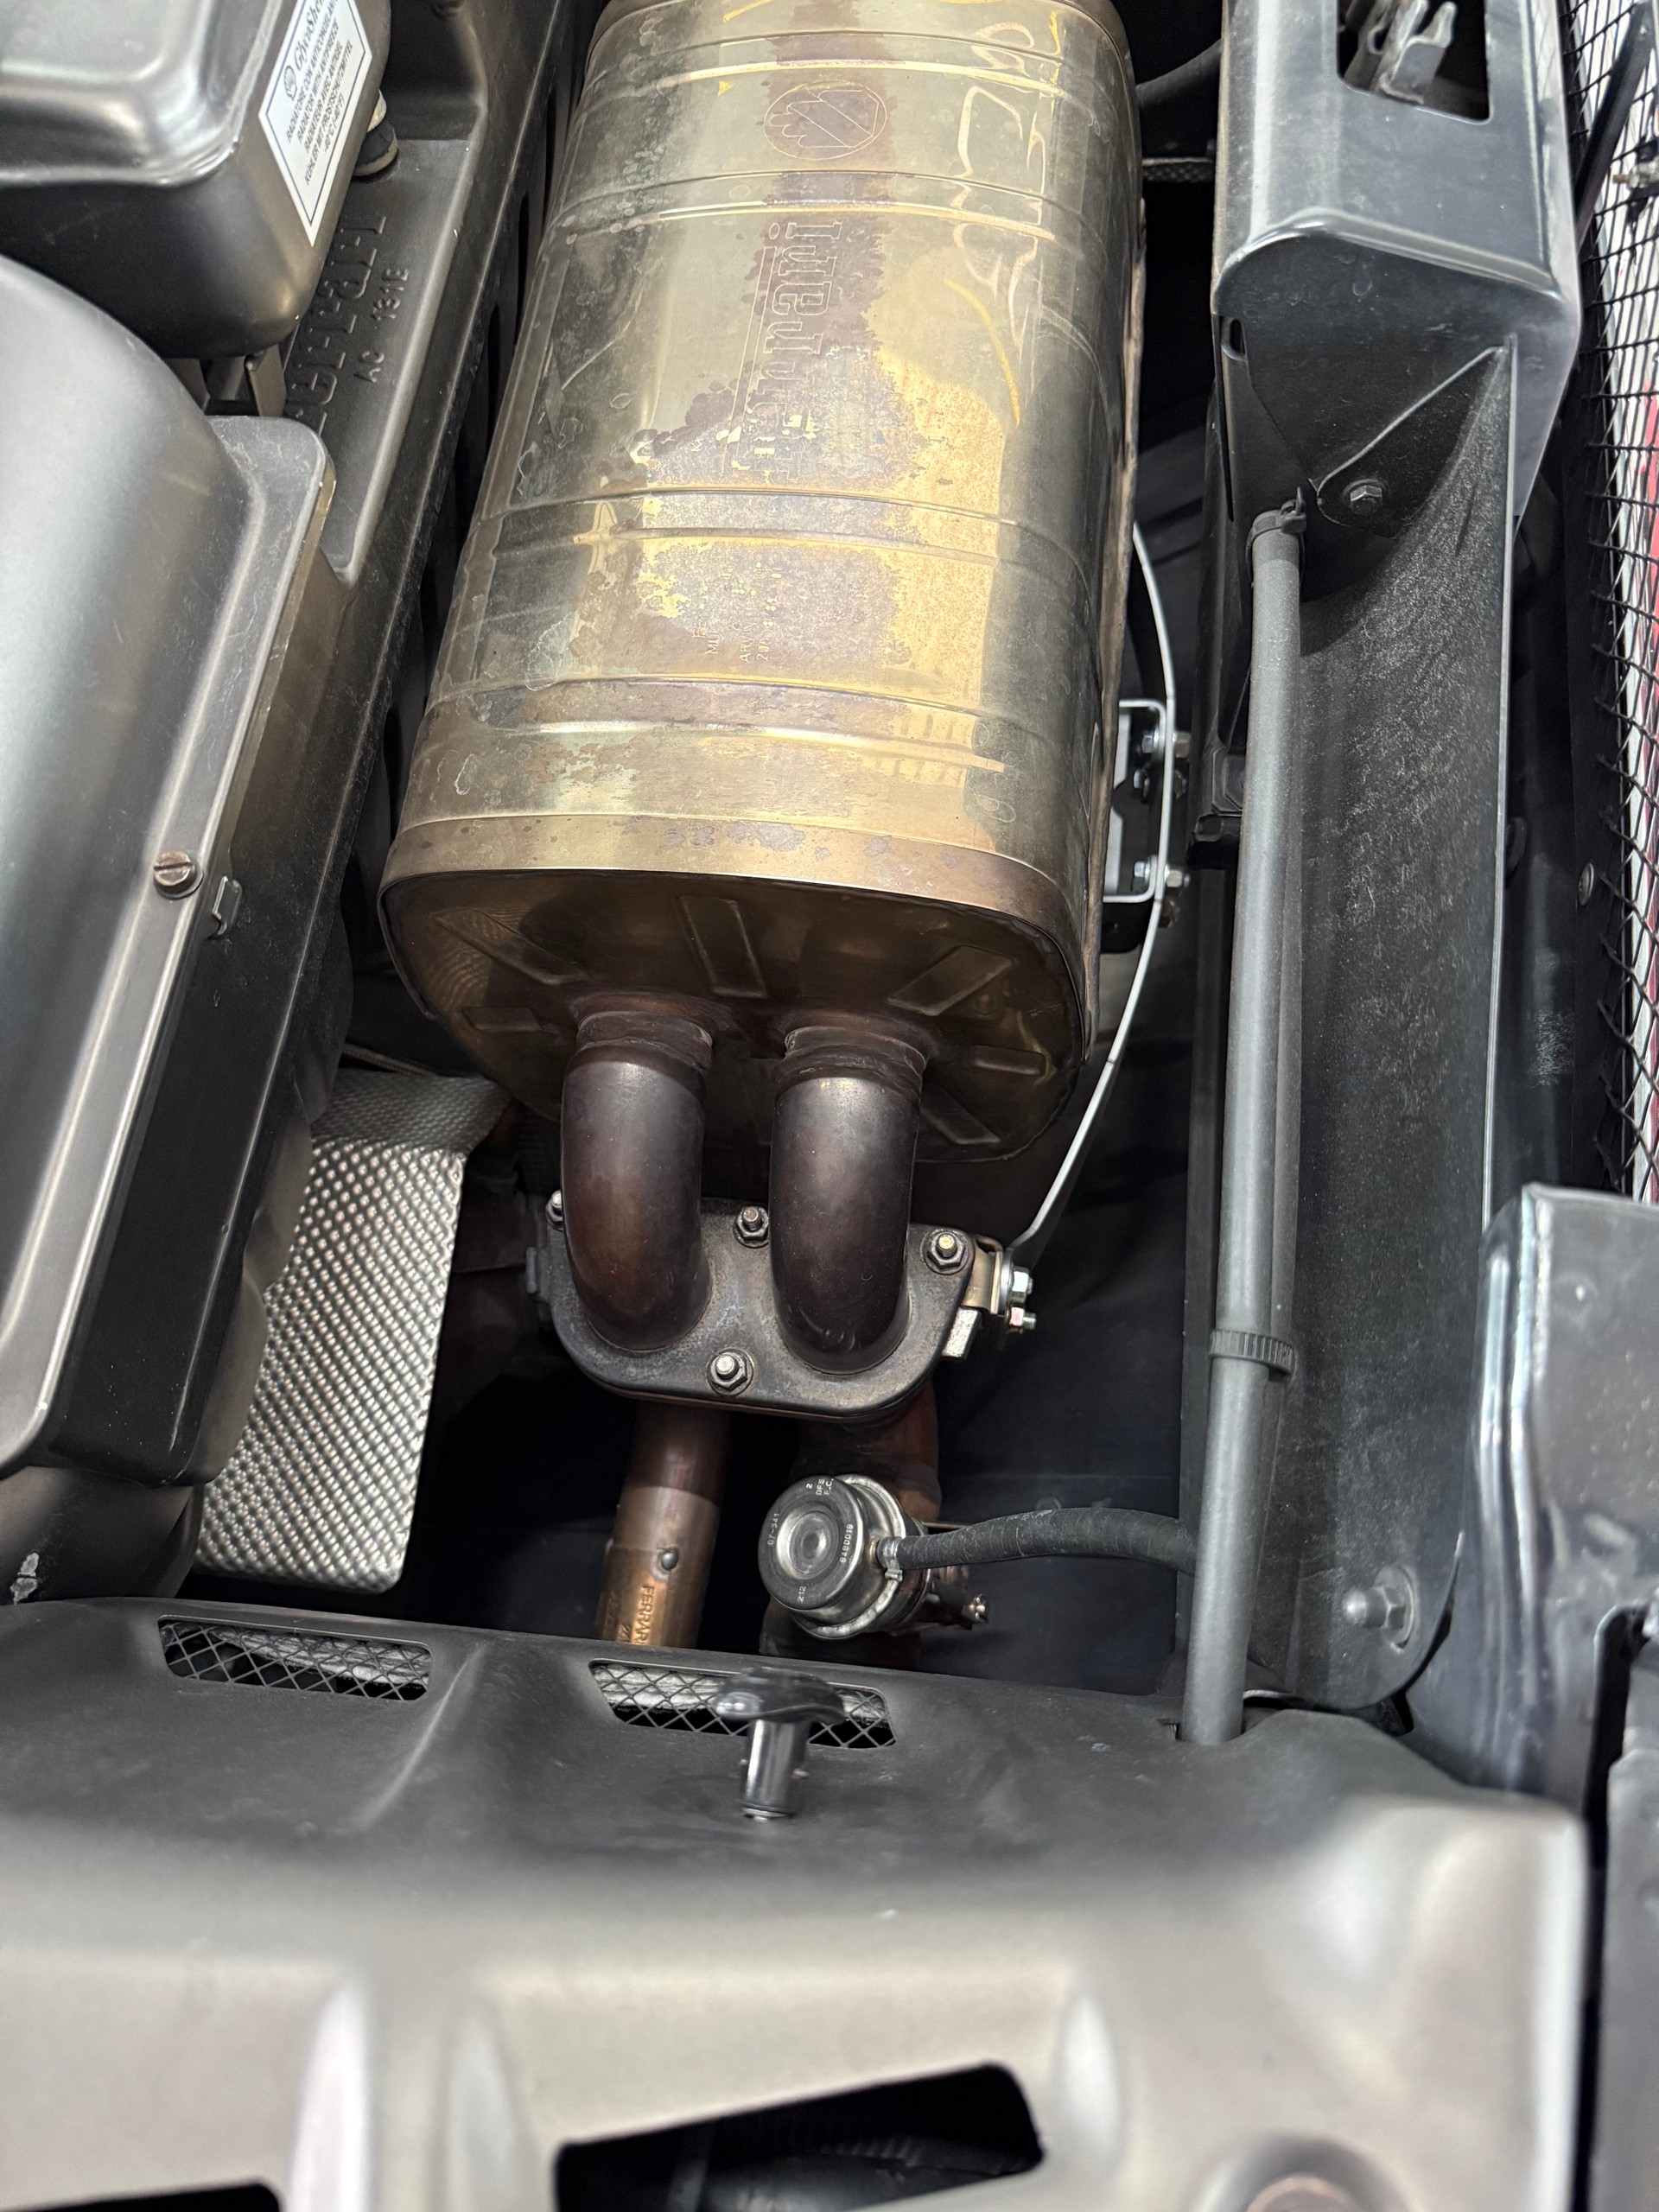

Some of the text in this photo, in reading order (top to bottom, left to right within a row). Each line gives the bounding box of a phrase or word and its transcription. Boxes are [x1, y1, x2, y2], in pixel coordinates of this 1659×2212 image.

[286, 86, 306, 143] RADIATORE
[303, 66, 313, 91] CON
[297, 18, 339, 144] RADIATOR WITH ANTIFREEZE
[304, 41, 343, 153] RADIATEUR AVEC ANTIGEL
[321, 40, 353, 132] FROSTSCHUTZMITTEL
[721, 221, 842, 480] Ferrari
[634, 1584, 655, 1645] FERRARI
[797, 1586, 807, 1604] 212
